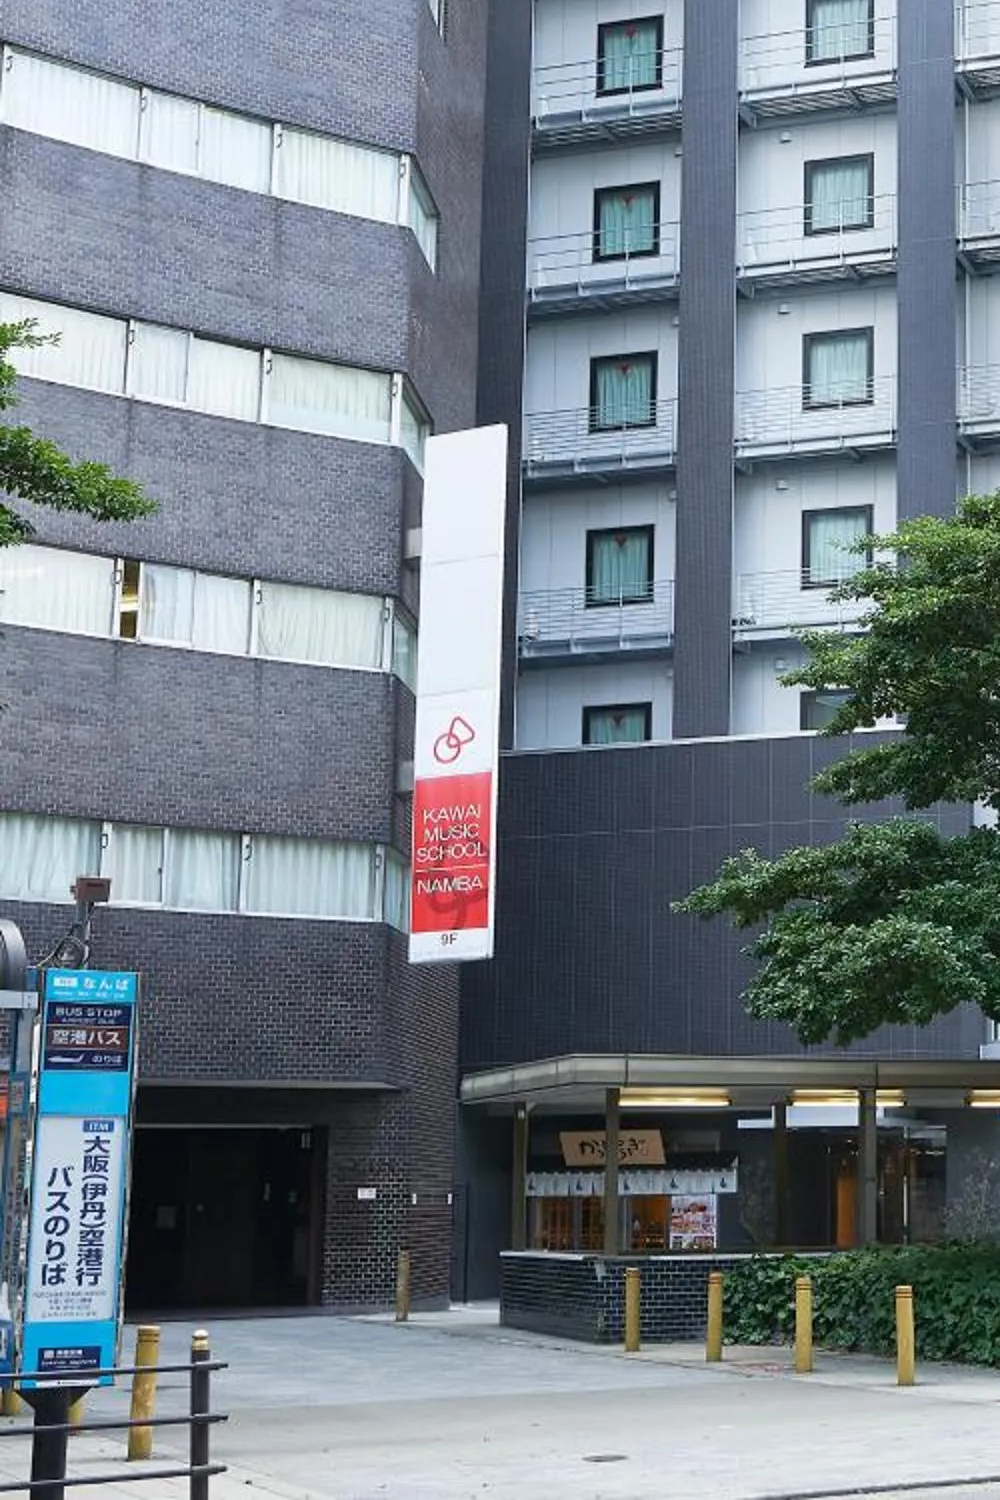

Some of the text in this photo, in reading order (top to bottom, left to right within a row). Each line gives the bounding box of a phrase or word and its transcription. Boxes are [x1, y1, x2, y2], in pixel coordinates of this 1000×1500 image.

[423, 804, 481, 825] KAWAI
[423, 823, 481, 843] MUSIC
[416, 842, 487, 863] SCHOOL
[417, 875, 483, 895] NAMBA
[440, 933, 458, 946] 9F
[83, 976, 129, 991] なんば
[55, 1007, 122, 1018] BUS STOP
[52, 1029, 121, 1045] 空港バス
[41, 1166, 74, 1287] バスのりば
